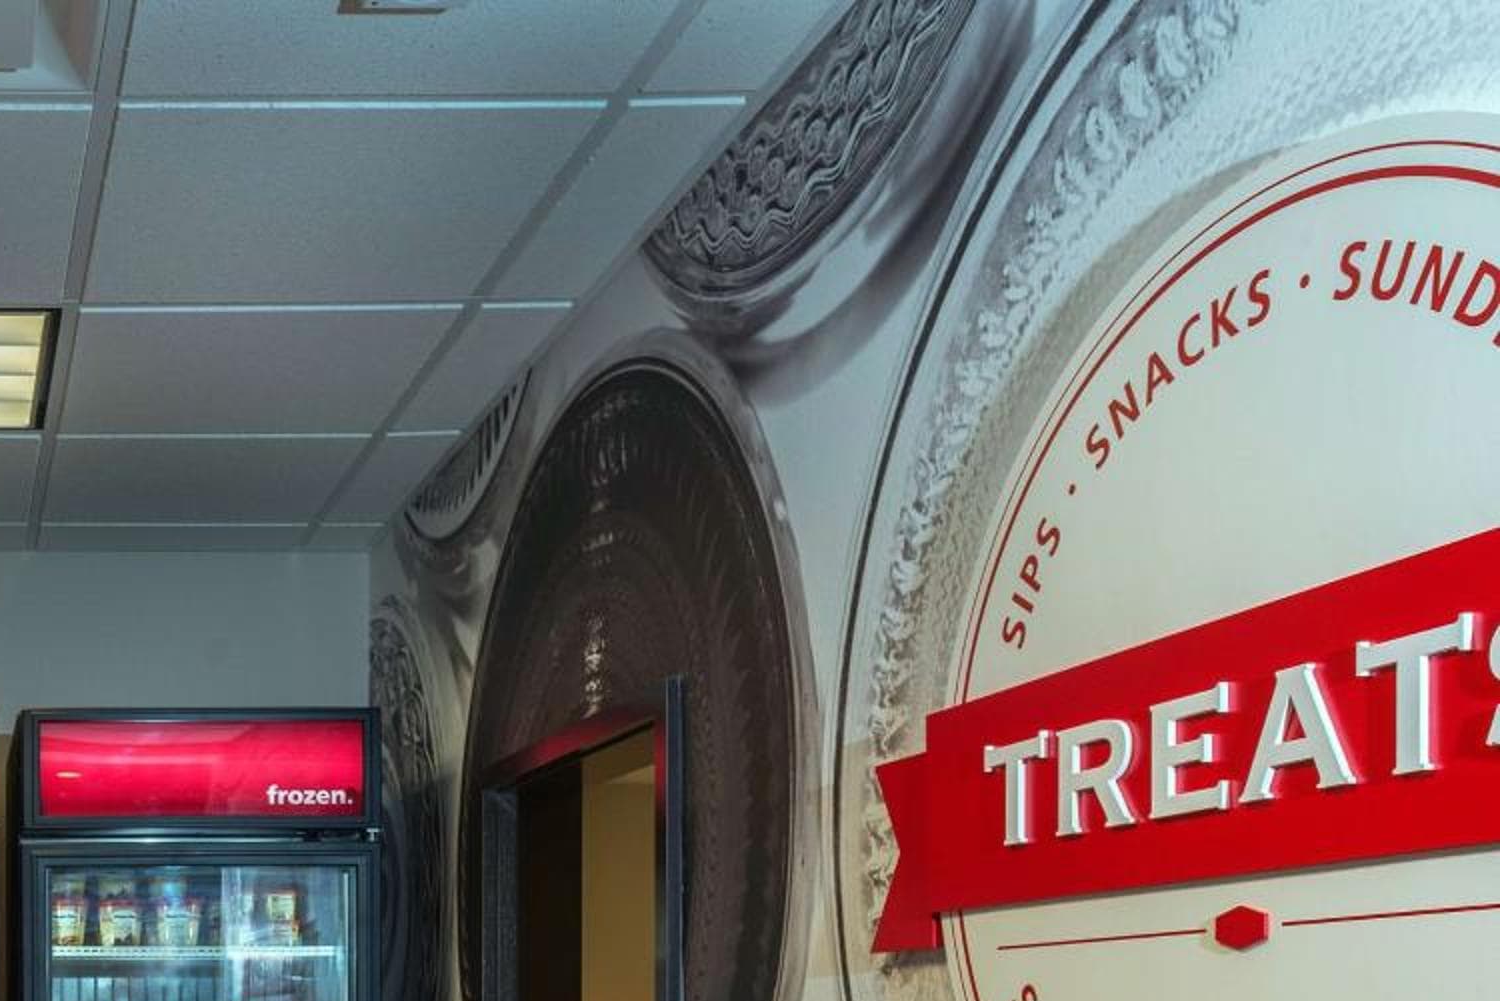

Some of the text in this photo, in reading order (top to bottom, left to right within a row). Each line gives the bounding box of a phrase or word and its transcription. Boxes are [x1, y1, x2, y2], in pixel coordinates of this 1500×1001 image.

[1002, 240, 1500, 650] SIPS SNACKS SUND
[266, 784, 353, 805] frozen.
